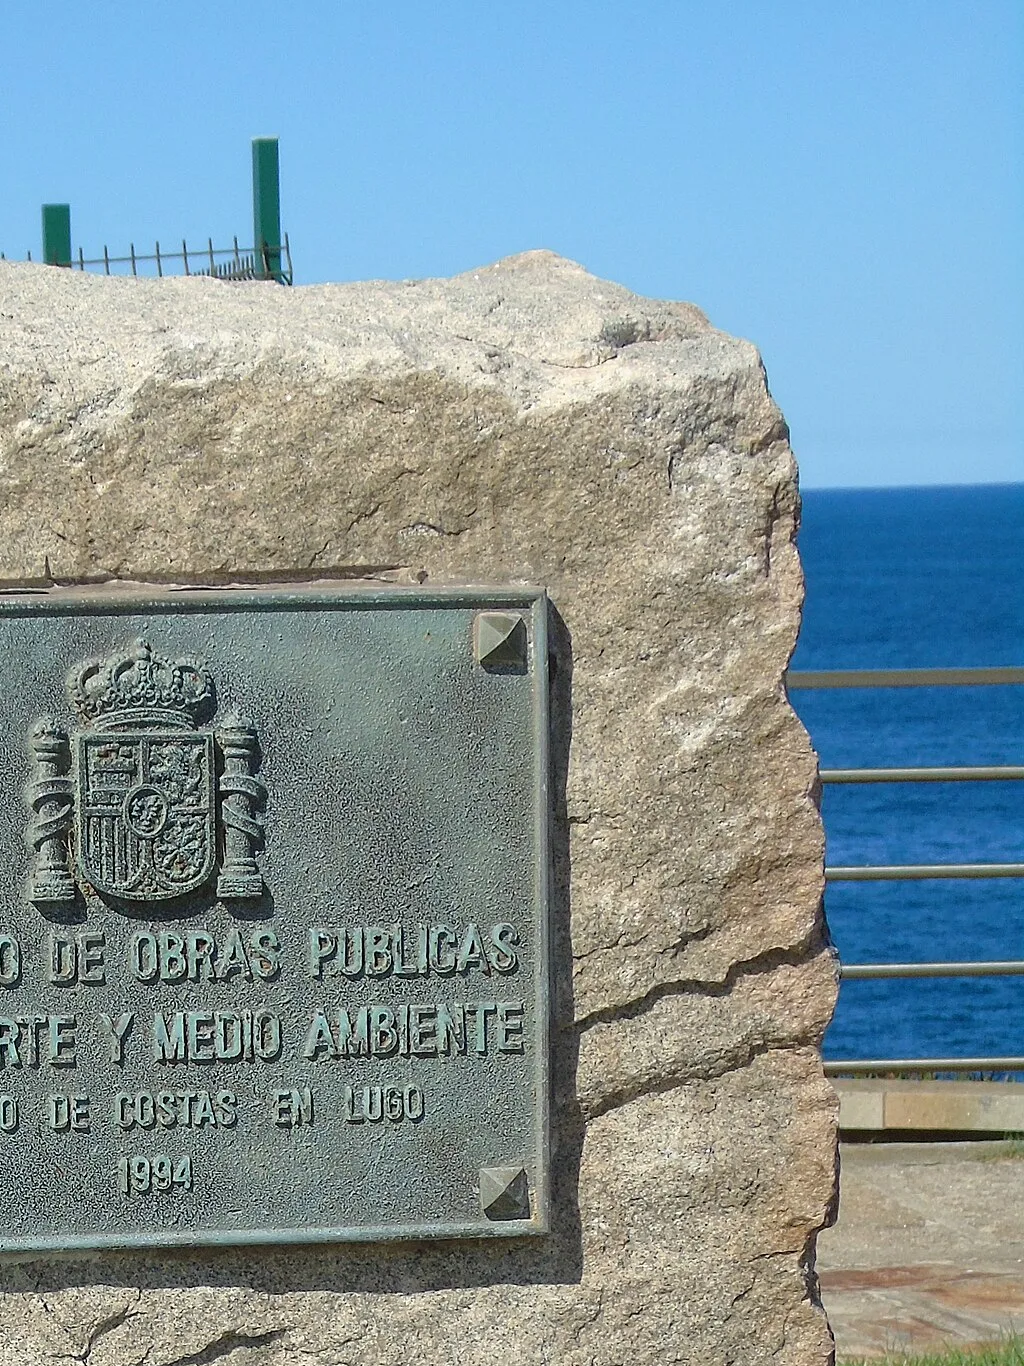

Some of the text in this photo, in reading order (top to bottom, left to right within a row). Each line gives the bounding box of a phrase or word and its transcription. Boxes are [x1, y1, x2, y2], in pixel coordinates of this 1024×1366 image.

[49, 931, 107, 986] DE
[130, 928, 279, 984] OBRAS
[308, 923, 520, 978] PUBLICAS
[99, 1012, 136, 1067] Y
[152, 1008, 283, 1065] MEDIO
[304, 1001, 526, 1058] AMBIENTE
[49, 1094, 92, 1131] DE
[114, 1090, 238, 1130] COSTAS
[275, 1088, 314, 1127] EN
[345, 1084, 426, 1124] LUGO
[117, 1155, 194, 1194] 1994
